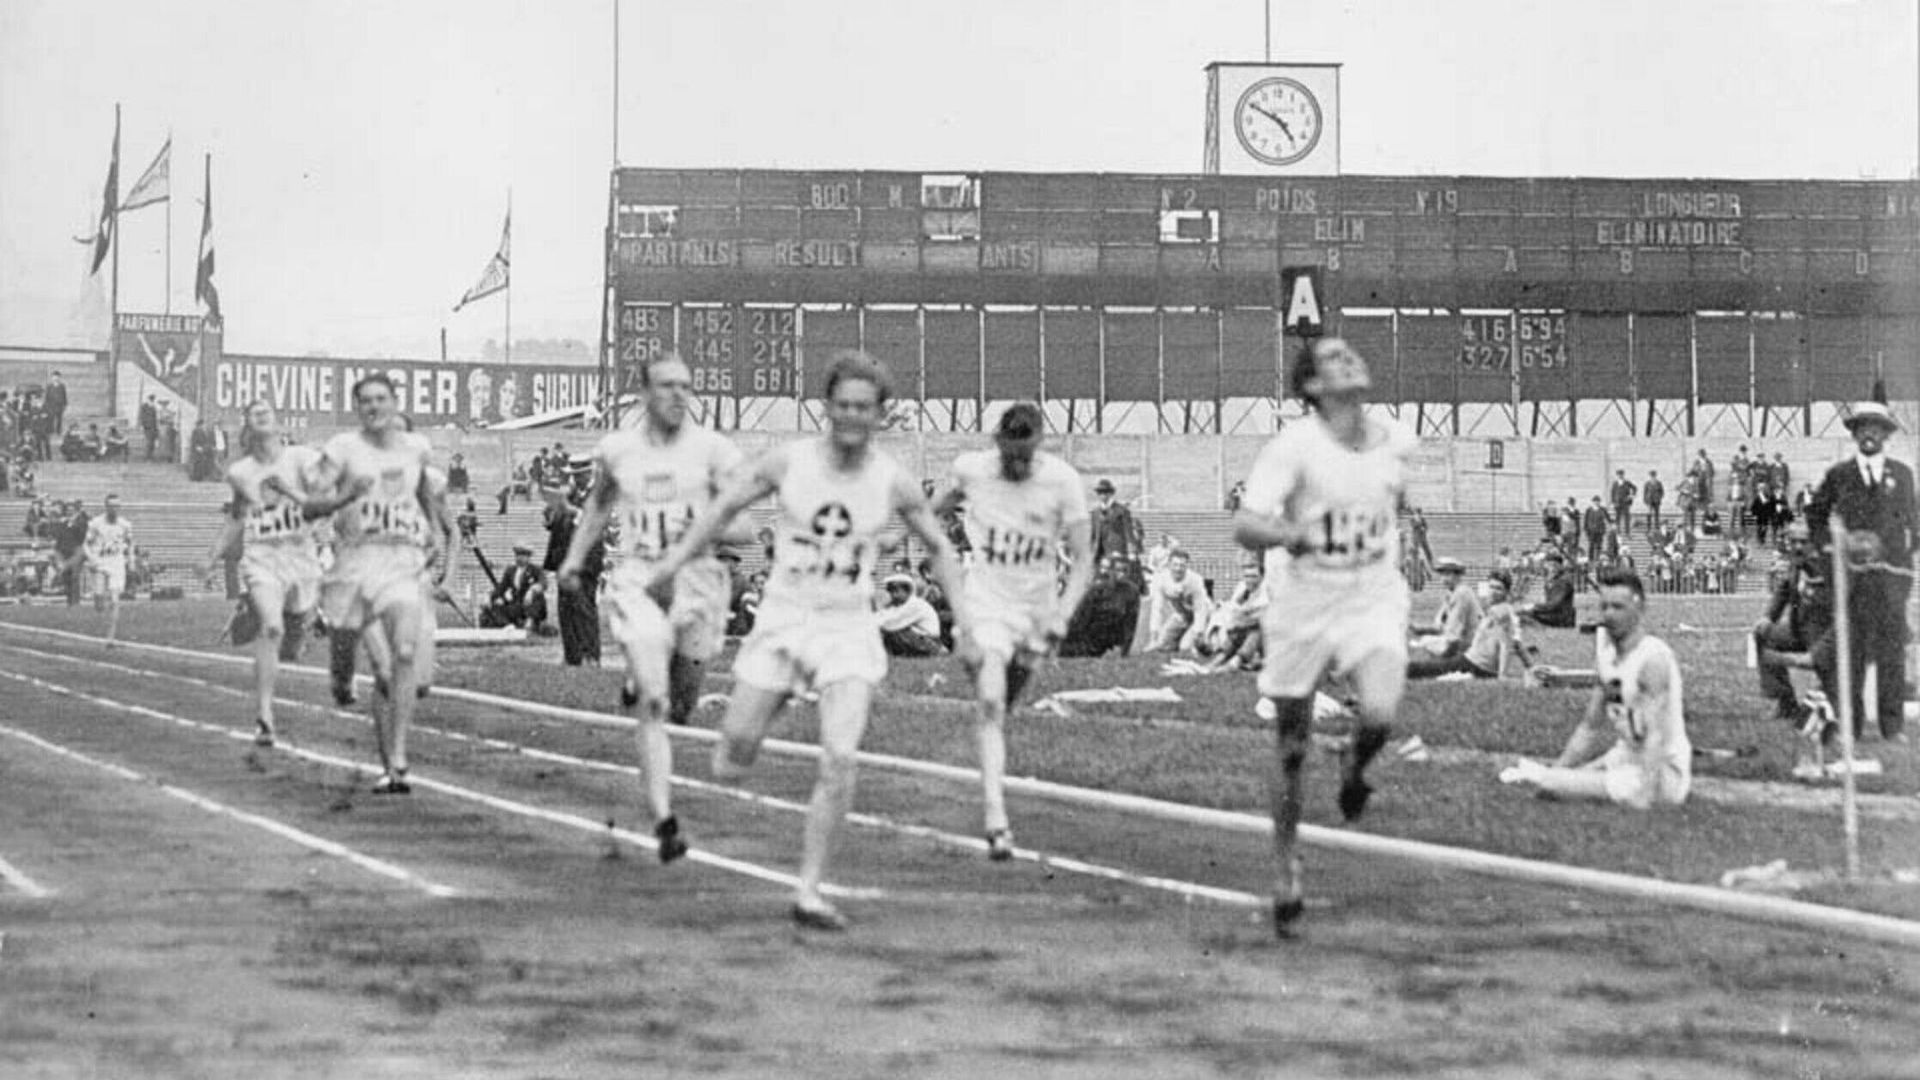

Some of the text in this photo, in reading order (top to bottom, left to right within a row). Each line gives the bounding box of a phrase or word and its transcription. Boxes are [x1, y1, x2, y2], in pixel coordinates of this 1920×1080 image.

[1255, 187, 1316, 212] POIDS
[1314, 217, 1365, 241] ELIM
[1597, 220, 1741, 245] ELIMINATOIRE
[774, 240, 859, 267] RESULT
[1286, 275, 1321, 327] A
[622, 308, 660, 332] 483
[693, 310, 733, 334] 452
[752, 311, 794, 335] 212
[1462, 317, 1506, 342] 416
[693, 338, 733, 363] 445
[752, 339, 793, 364] 214
[1462, 345, 1510, 370] 327
[217, 362, 333, 412] CHEVINE
[344, 366, 457, 415] NGER
[753, 367, 792, 392] 681
